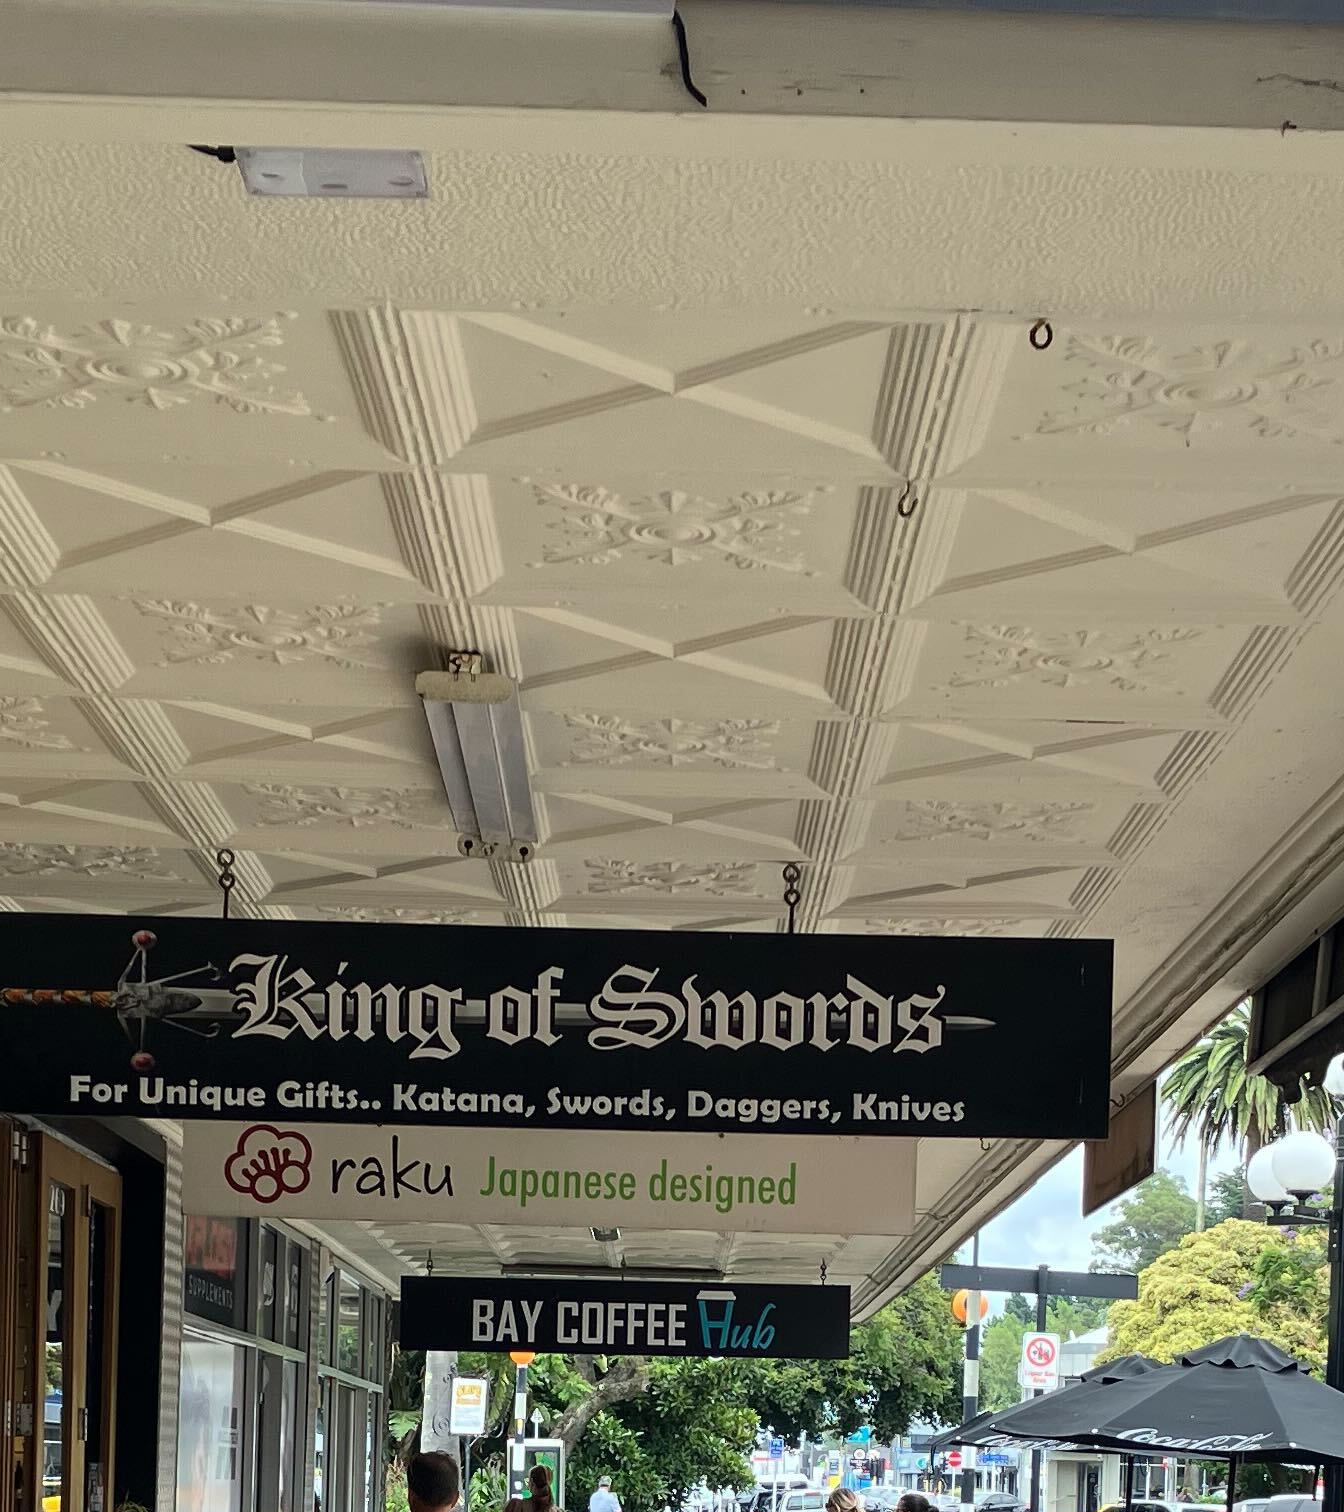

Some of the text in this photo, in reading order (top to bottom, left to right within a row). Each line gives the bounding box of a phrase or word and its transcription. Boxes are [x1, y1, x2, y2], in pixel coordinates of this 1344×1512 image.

[228, 953, 947, 1060] King of Swords
[69, 1074, 965, 1125] For Unique Gifts.. Katana, Swords, Daggers, Knives
[331, 1135, 797, 1213] raku Japanese designed
[472, 1294, 777, 1350] BAY COFFEE Hub
